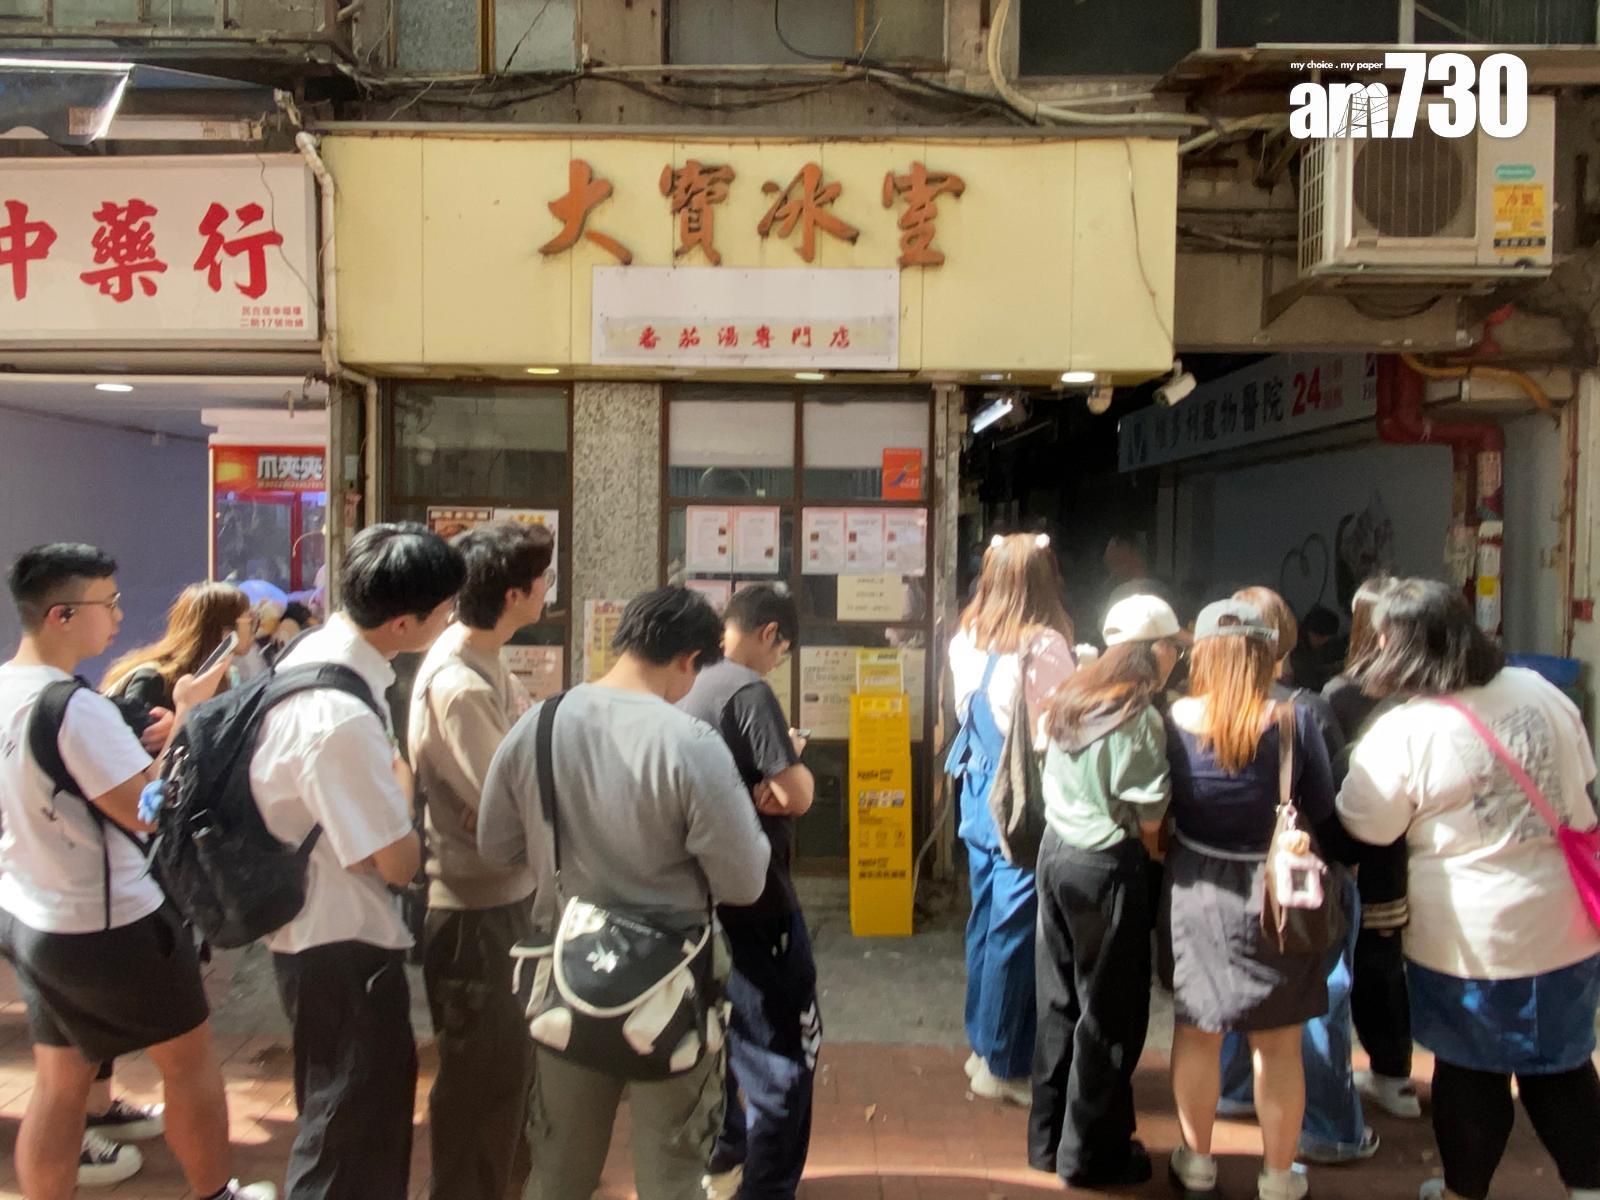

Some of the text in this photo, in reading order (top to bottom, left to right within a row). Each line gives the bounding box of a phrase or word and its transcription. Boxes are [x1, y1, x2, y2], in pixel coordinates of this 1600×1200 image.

[0, 198, 284, 302] 中藥行
[538, 158, 966, 267] 大寶冰室
[639, 325, 851, 350] 番茄湯專門店
[1291, 367, 1322, 418] 24
